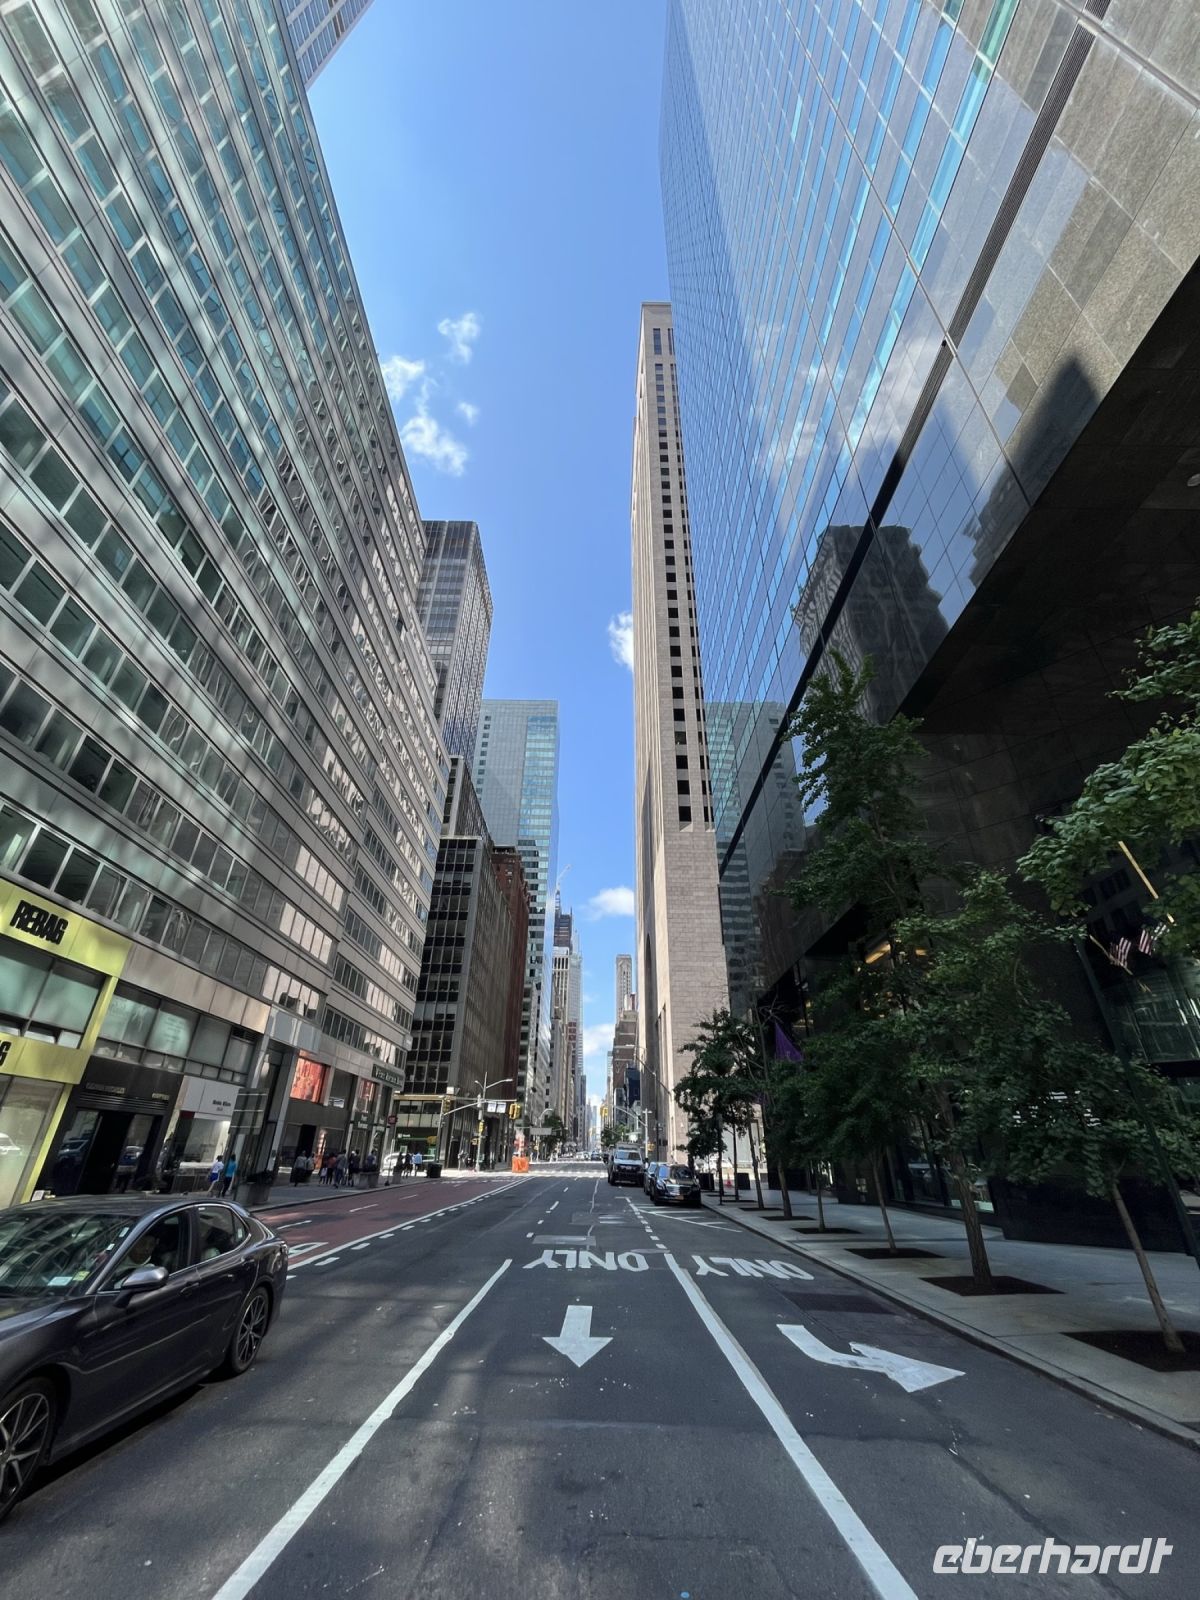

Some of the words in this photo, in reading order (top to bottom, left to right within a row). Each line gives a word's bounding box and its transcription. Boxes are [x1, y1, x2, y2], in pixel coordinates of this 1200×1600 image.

[10, 900, 68, 944] REBAG
[523, 1249, 650, 1272] ONLY
[692, 1255, 815, 1280] ONLY
